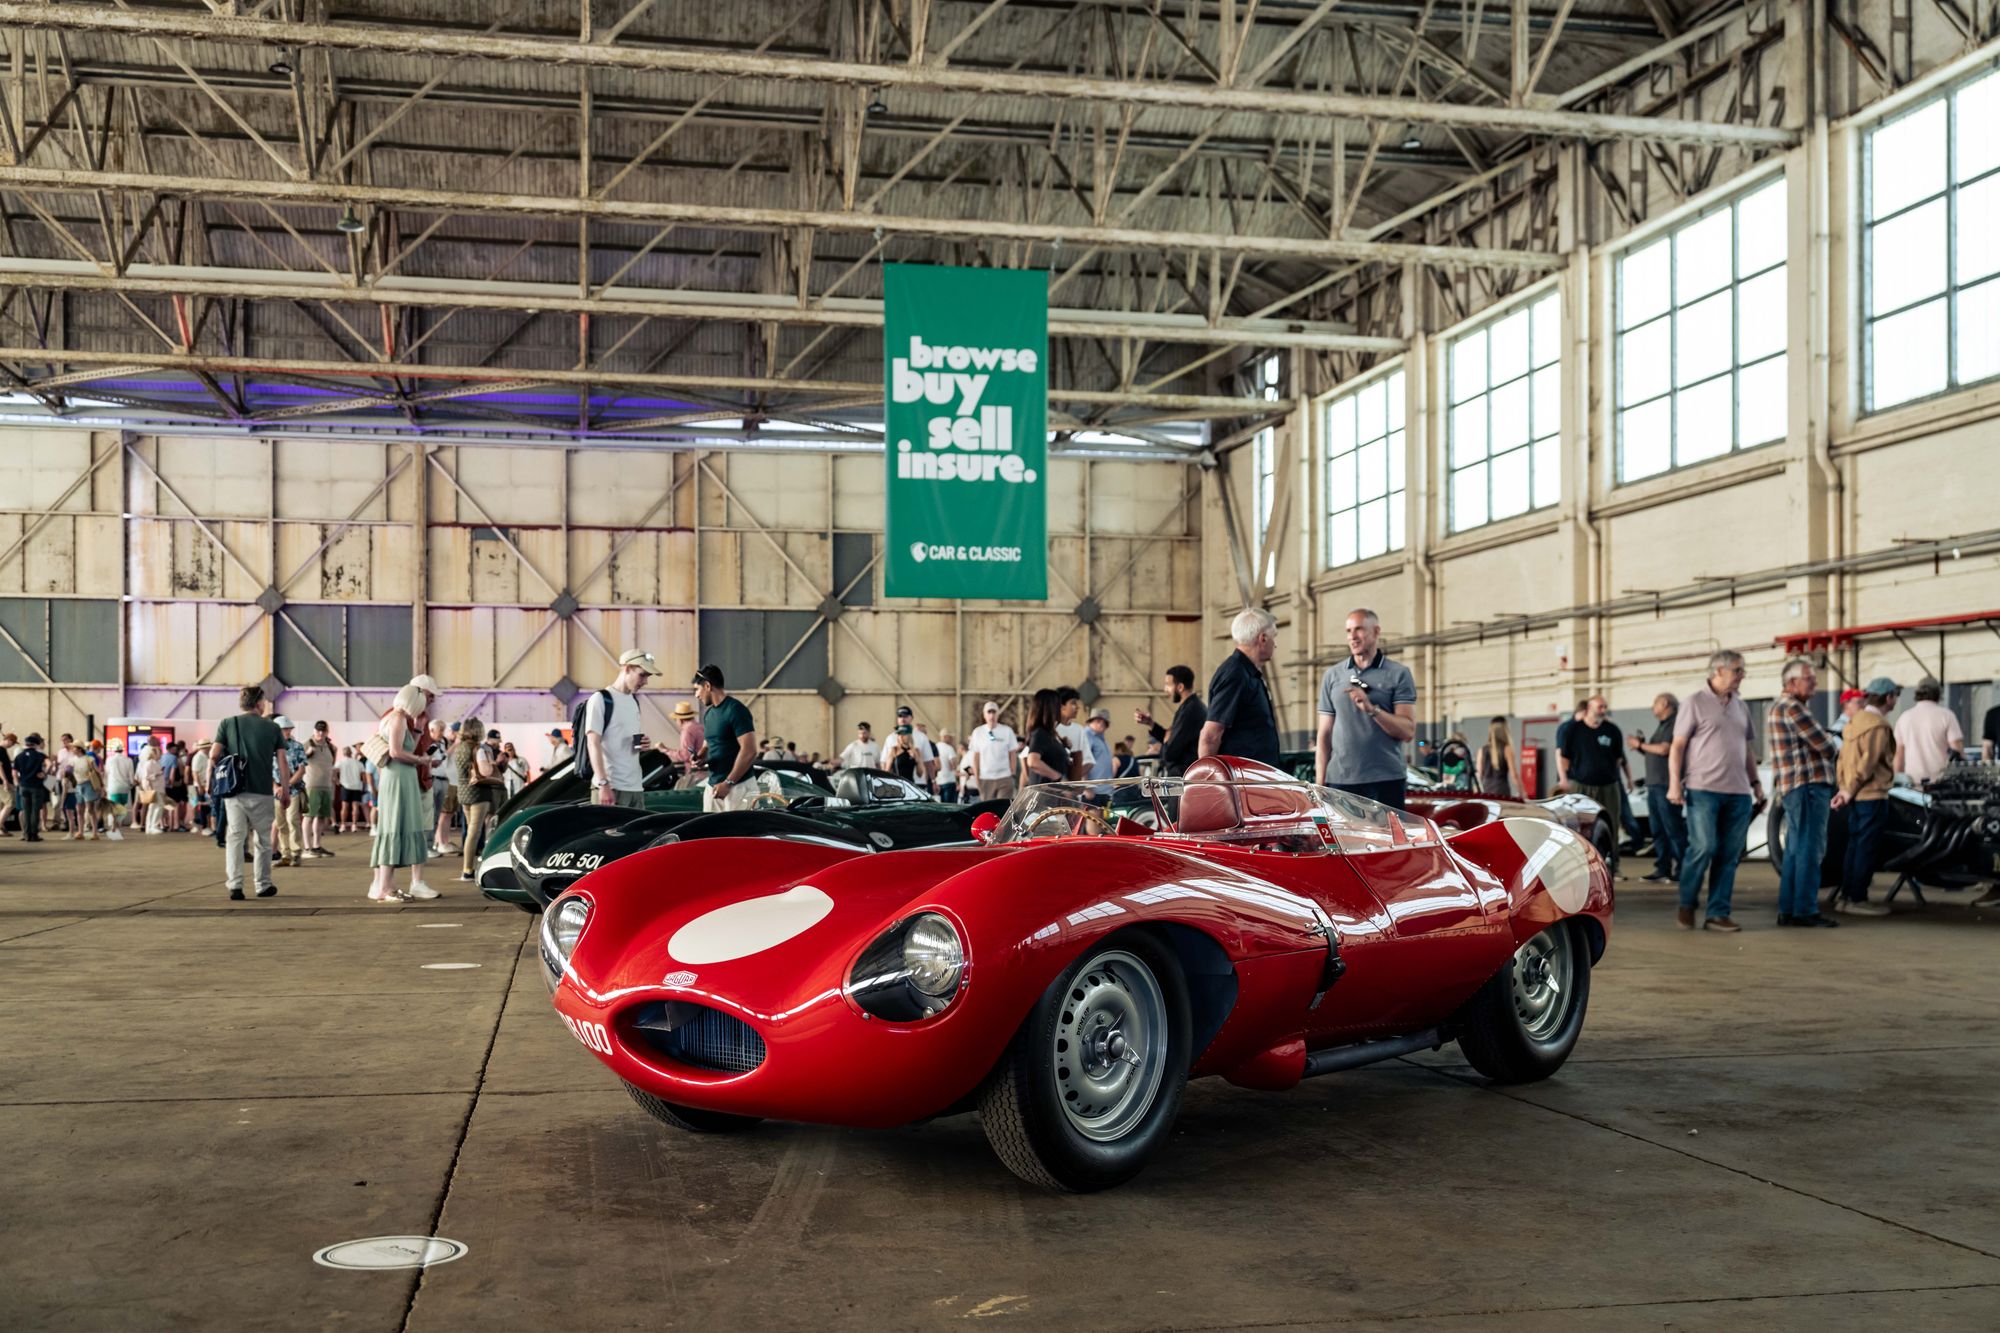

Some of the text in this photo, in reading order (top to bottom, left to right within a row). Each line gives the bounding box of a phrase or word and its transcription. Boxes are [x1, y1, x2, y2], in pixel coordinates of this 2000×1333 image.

[910, 335, 1038, 373] browse
[892, 357, 990, 416] buy
[928, 405, 1013, 451] sell
[897, 439, 1037, 483] insure.
[929, 545, 1022, 562] CAR & CLASSIC
[1321, 827, 1332, 839] 2
[546, 852, 575, 868] OVC
[666, 972, 694, 985] JAGUAR
[1077, 1007, 1090, 1036] DUNLOP
